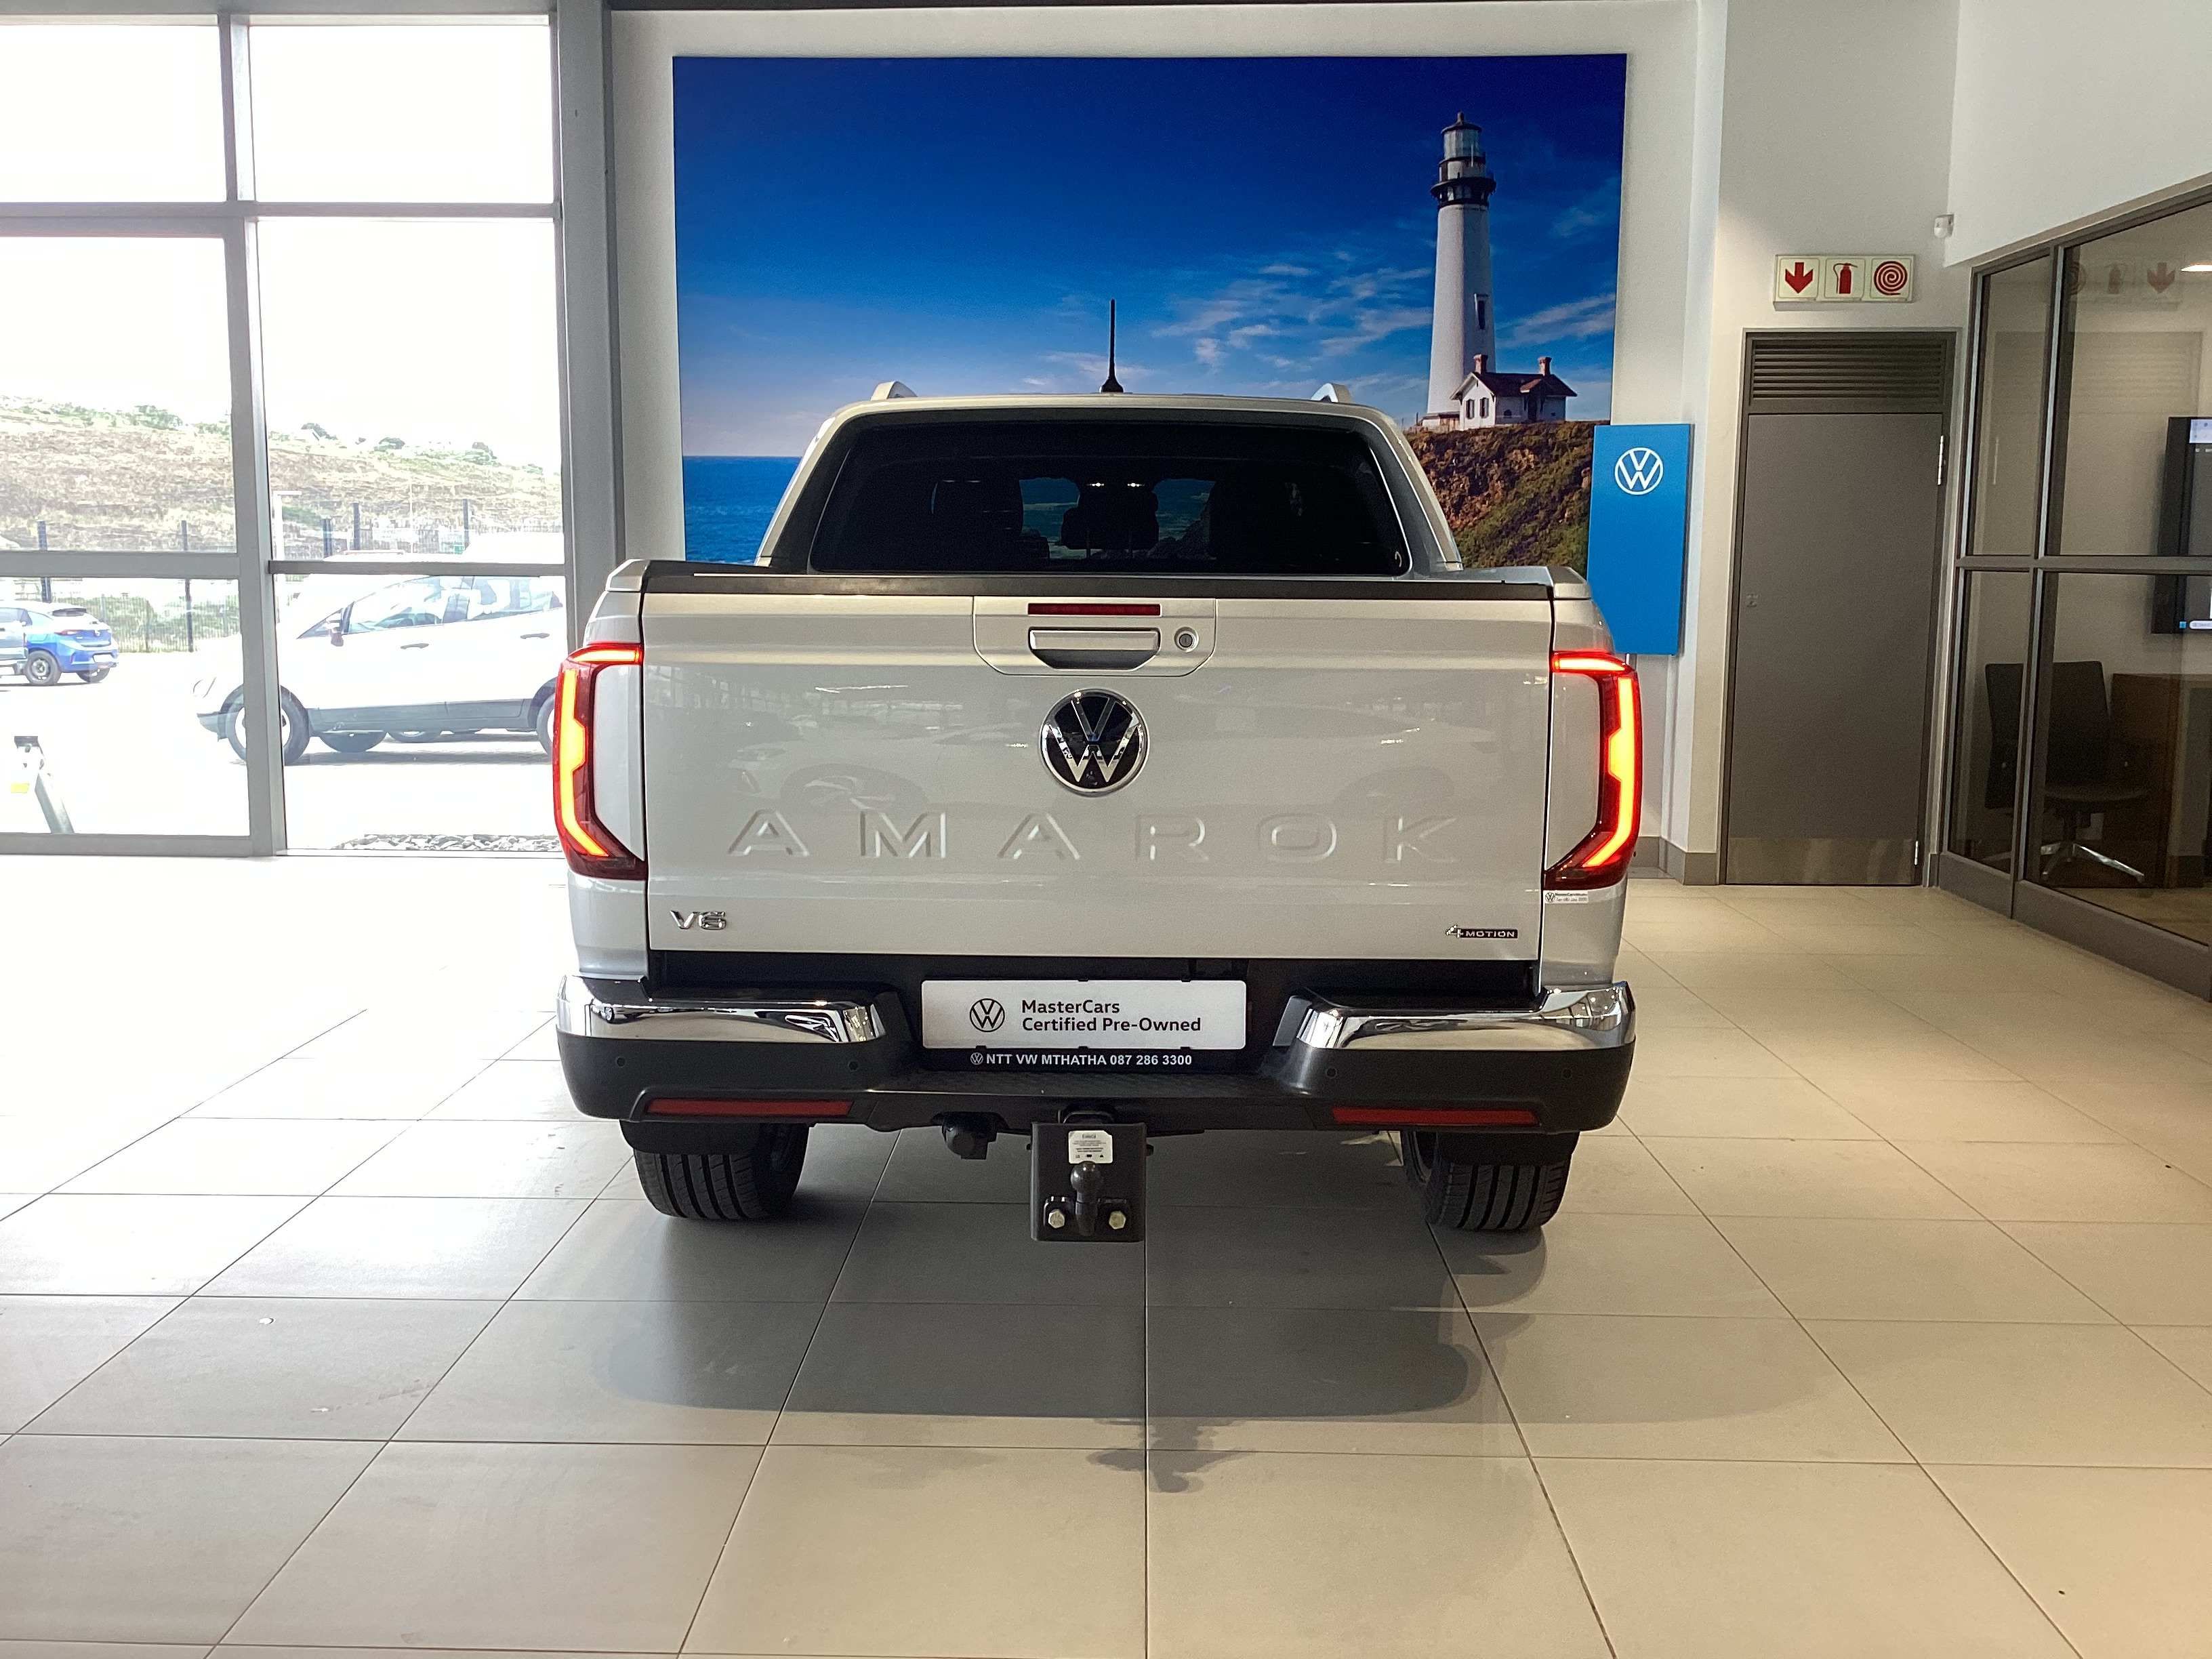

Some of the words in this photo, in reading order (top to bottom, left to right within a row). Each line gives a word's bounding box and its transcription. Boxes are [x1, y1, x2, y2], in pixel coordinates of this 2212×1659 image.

[1614, 447, 1664, 495] VW
[1040, 688, 1150, 797] VW
[728, 809, 1460, 864] AMAROK
[669, 910, 726, 930] V6
[969, 998, 1006, 1033] VW
[1021, 999, 1120, 1014] MasterCars
[1022, 1017, 1097, 1031] Certified
[1103, 1017, 1202, 1031] Pre-Owned
[986, 1054, 1012, 1064] NTT
[1017, 1054, 1038, 1065] VW
[1042, 1054, 1107, 1065] MTHATHA
[1110, 1054, 1132, 1065] 087
[1136, 1054, 1158, 1065] 286
[1162, 1054, 1192, 1065] 3300
